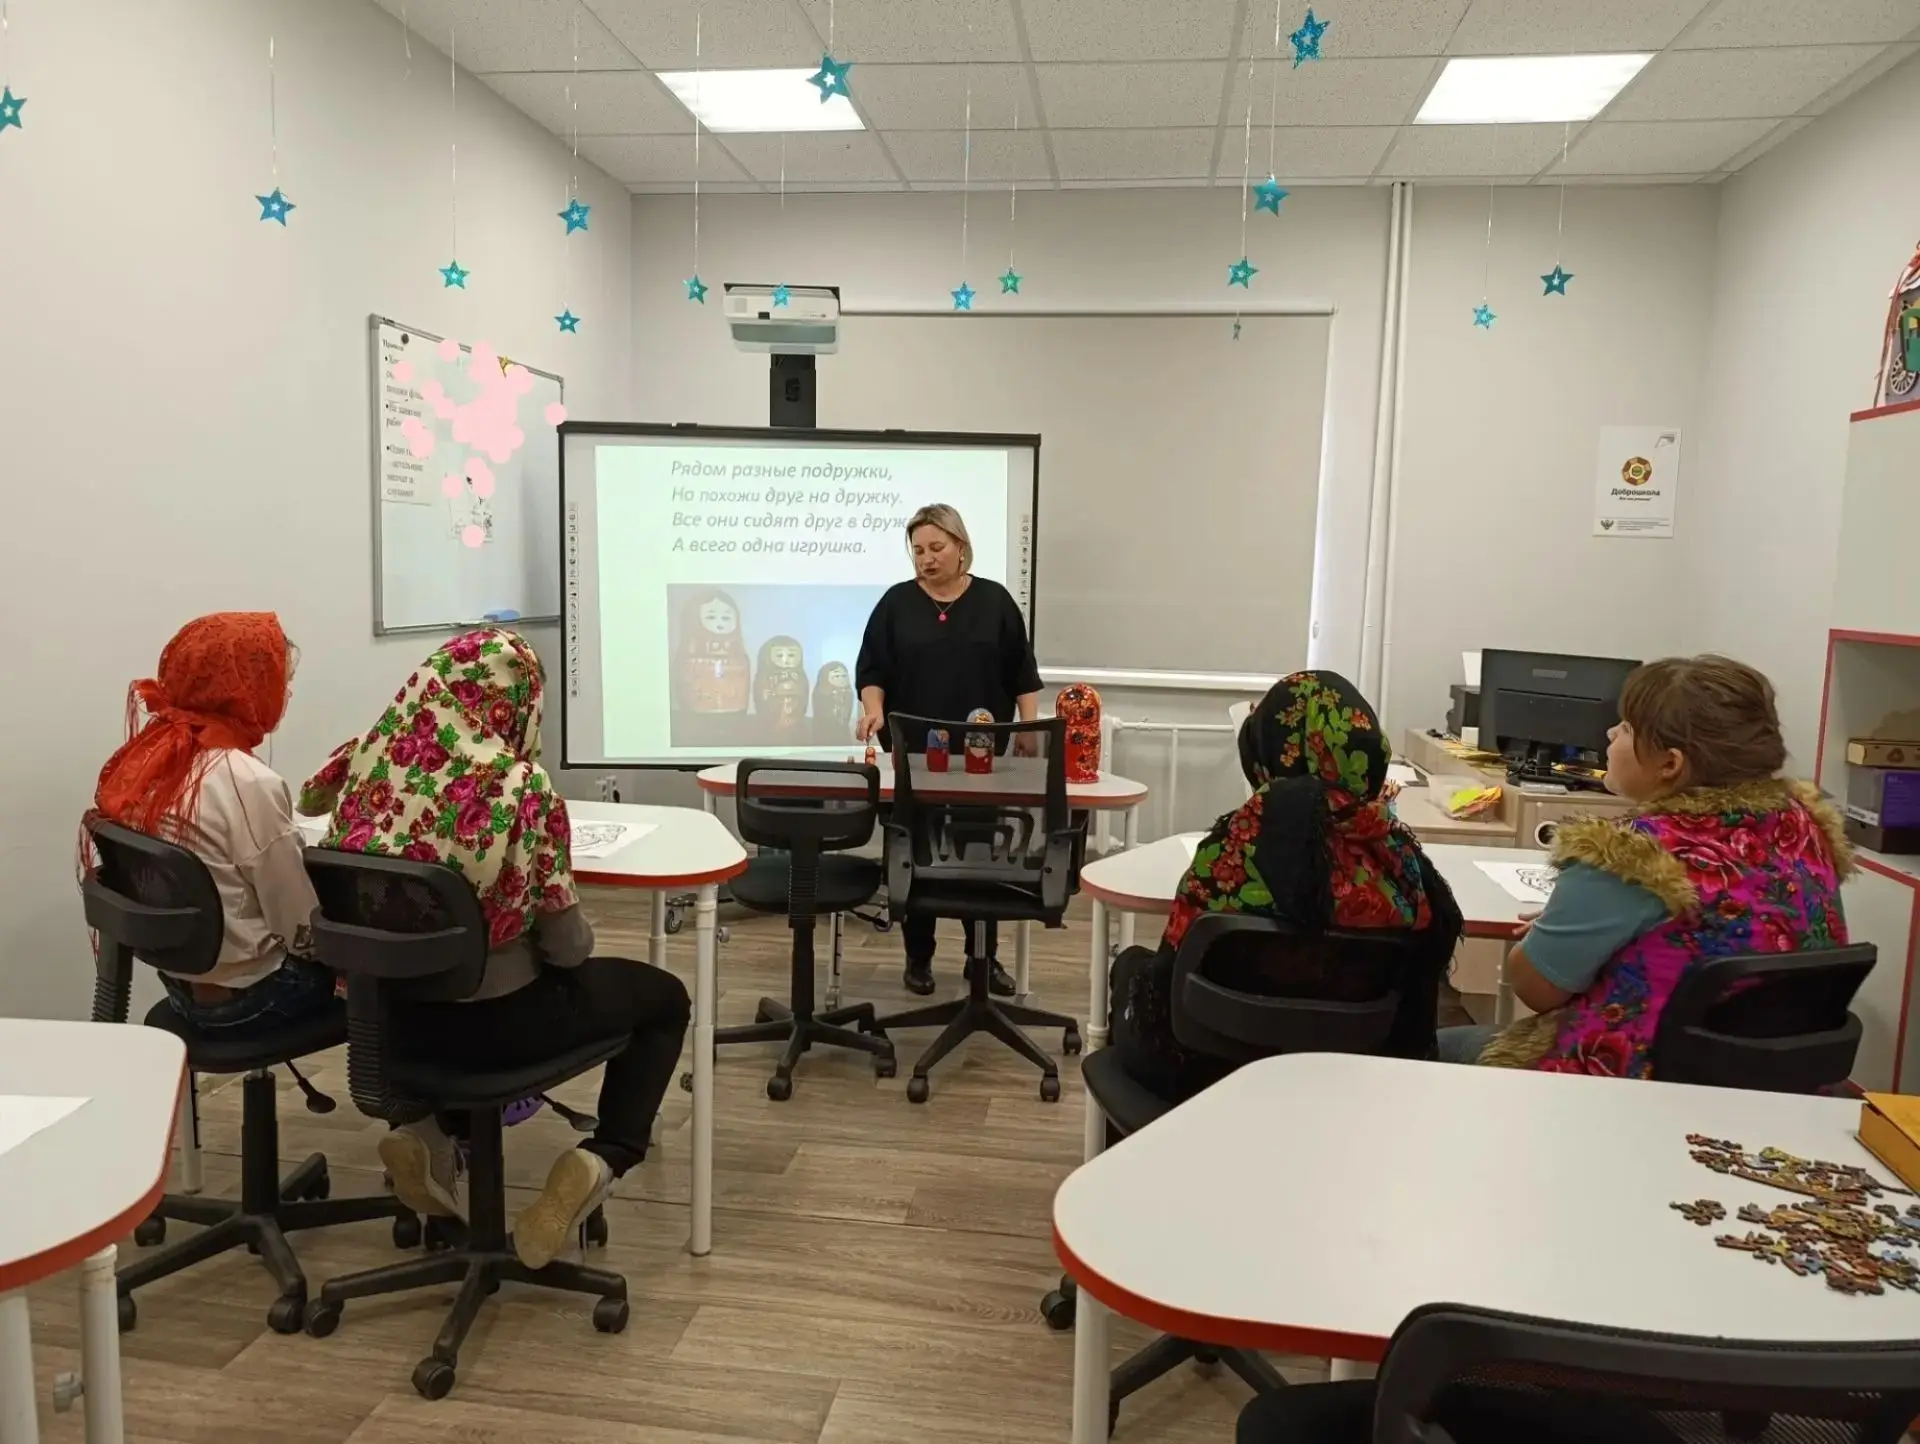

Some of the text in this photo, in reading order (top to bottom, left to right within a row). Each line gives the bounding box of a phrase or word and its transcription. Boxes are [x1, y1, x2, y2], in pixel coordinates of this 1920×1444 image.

[671, 460, 893, 481] Рядом разные подружки,
[700, 490, 760, 502] похожи
[765, 487, 804, 505] друг
[809, 491, 830, 503] на
[835, 488, 903, 507] дружку.
[1611, 488, 1661, 496] Доброшкола
[672, 512, 702, 527] Все
[706, 516, 739, 527] они
[744, 512, 799, 528] сидят
[805, 513, 843, 532] друг
[848, 518, 857, 528] в
[672, 537, 866, 556] А всего одна игрушка.
